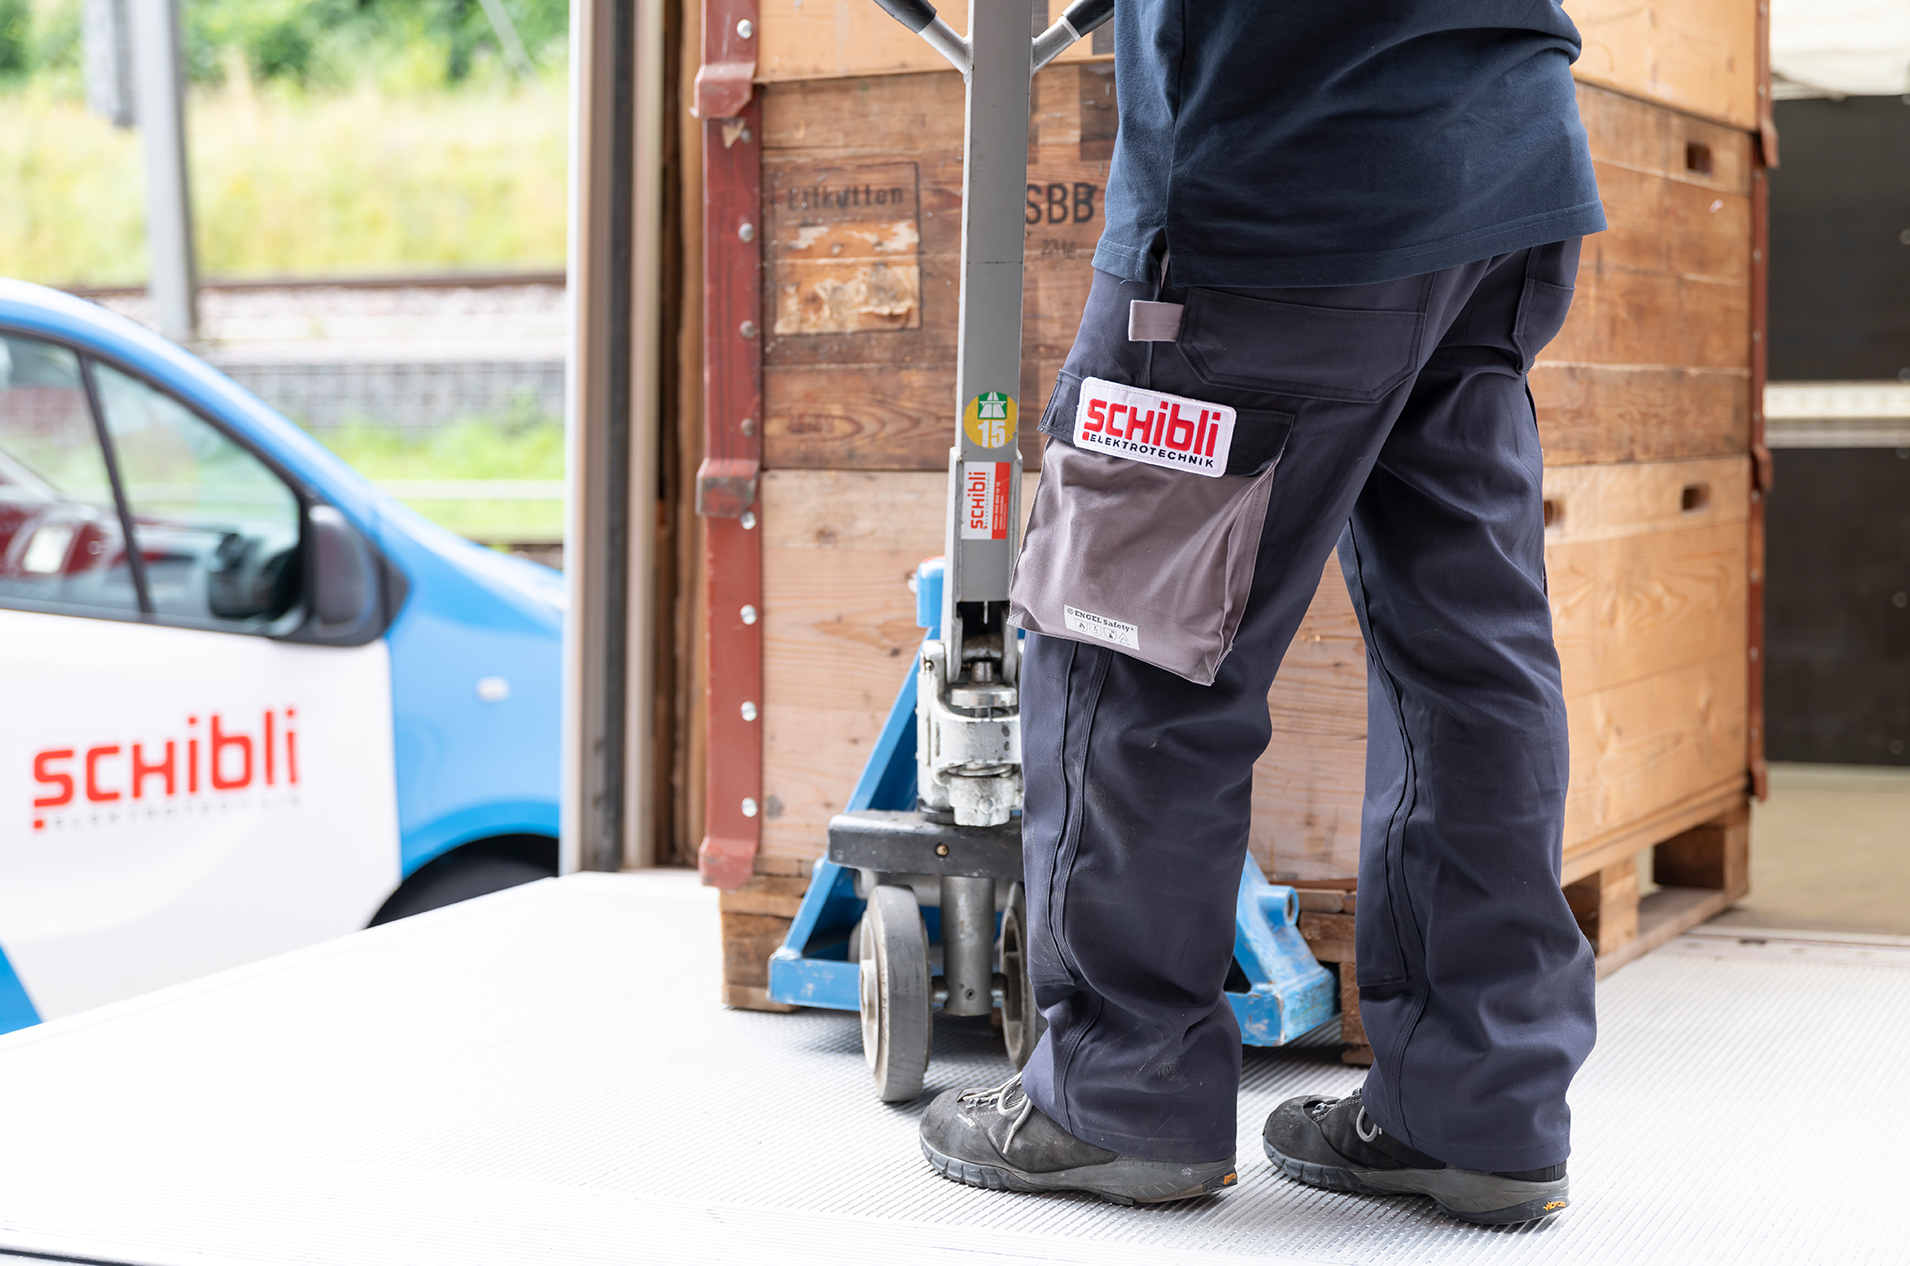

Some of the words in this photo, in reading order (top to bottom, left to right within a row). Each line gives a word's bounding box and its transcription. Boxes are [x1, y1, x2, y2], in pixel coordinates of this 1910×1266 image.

[1025, 182, 1095, 226] SBB
[978, 420, 1006, 449] 15
[1089, 433, 1215, 469] ELEKTROTECHNIK
[1075, 610, 1102, 624] ENGEL
